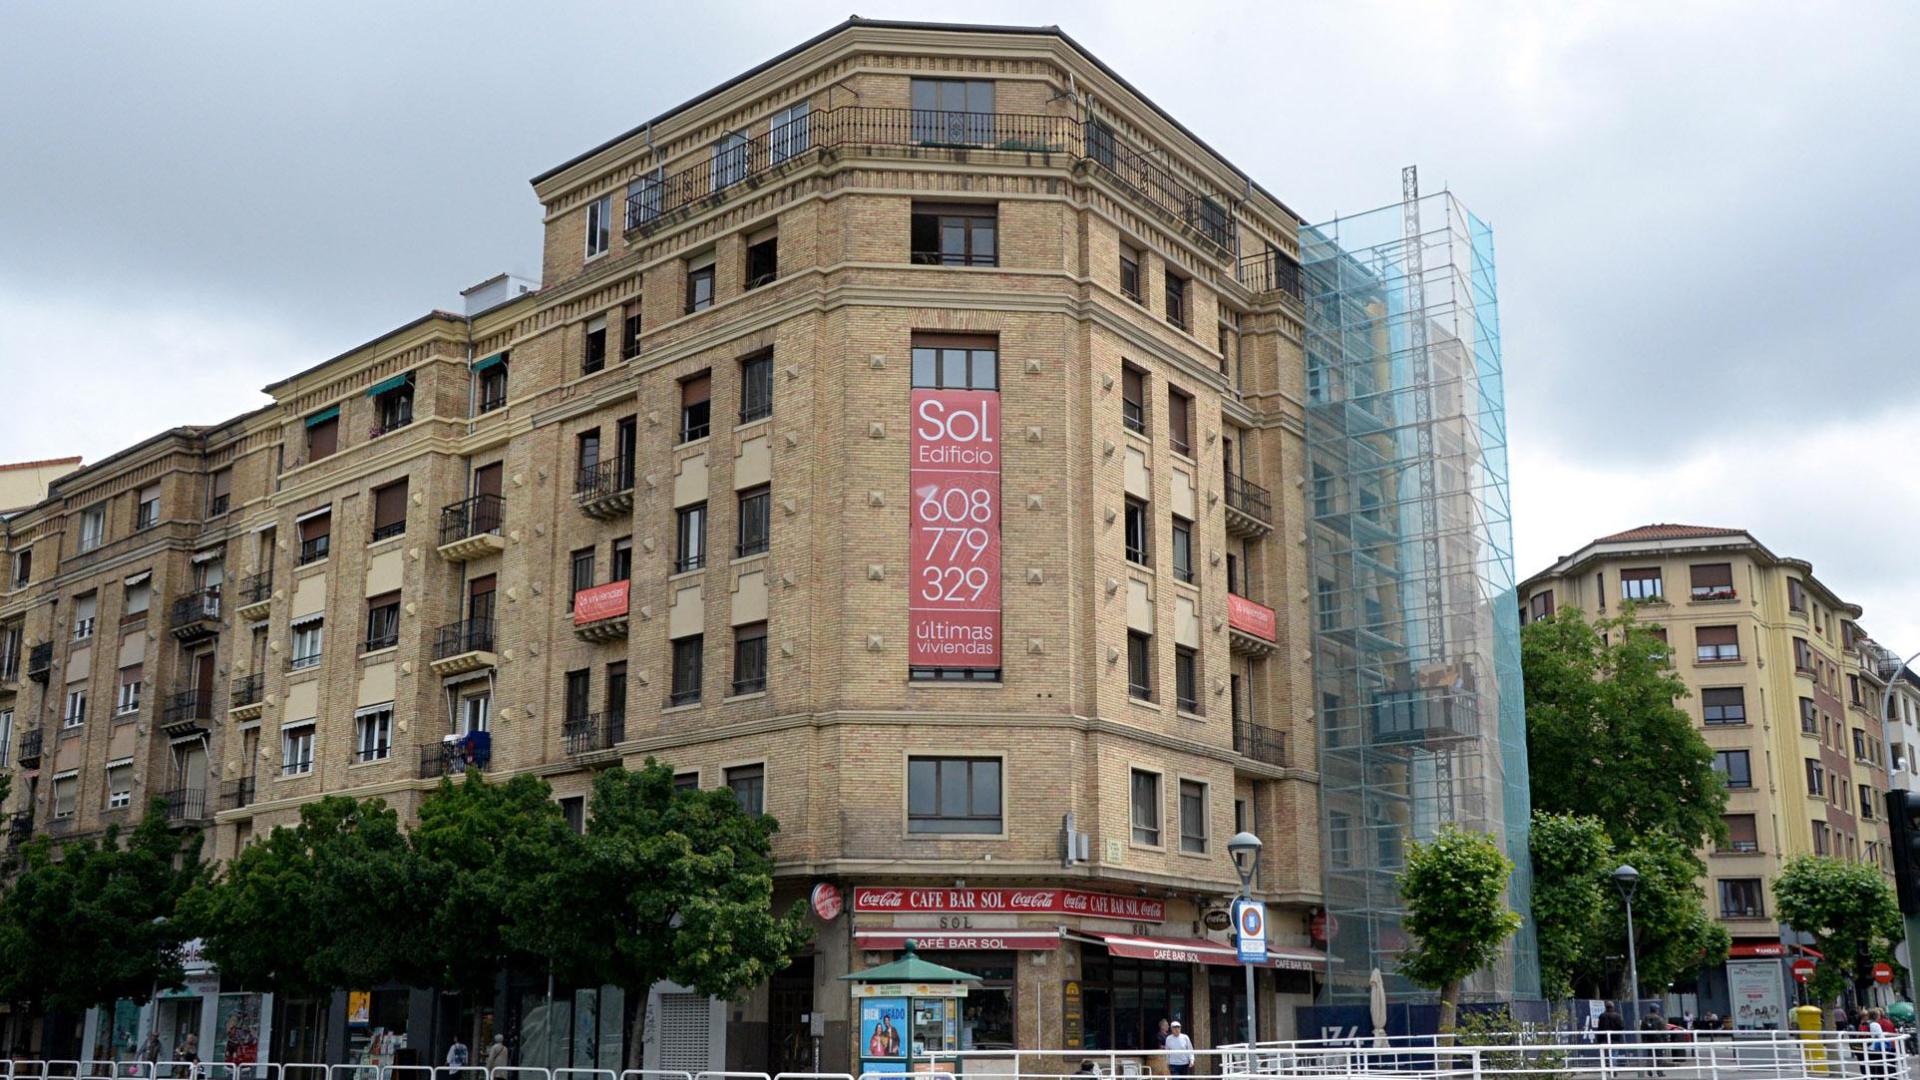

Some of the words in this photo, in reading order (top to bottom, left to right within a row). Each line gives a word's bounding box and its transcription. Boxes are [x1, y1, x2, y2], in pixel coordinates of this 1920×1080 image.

[918, 399, 993, 442] Sol
[919, 445, 993, 464] Edificio
[919, 487, 992, 523] 608
[922, 526, 989, 562] 779
[922, 566, 989, 602] 329
[916, 621, 993, 641] últimas
[916, 639, 993, 655] viviendas
[858, 890, 904, 908] Coca-Cola
[910, 891, 944, 908] CAFE
[949, 891, 976, 909] BAR
[980, 891, 1006, 909] SOL
[1010, 891, 1055, 908] Coca-Cola
[1090, 895, 1109, 913] CAFE
[1110, 898, 1125, 914] BAR
[1125, 899, 1140, 916] SOL
[938, 915, 974, 929] SOL
[948, 938, 977, 950] BAR
[980, 938, 1008, 950] SOL
[1153, 949, 1172, 961] CAFÉ
[1172, 951, 1187, 962] BAR
[1187, 952, 1200, 963] SOL
